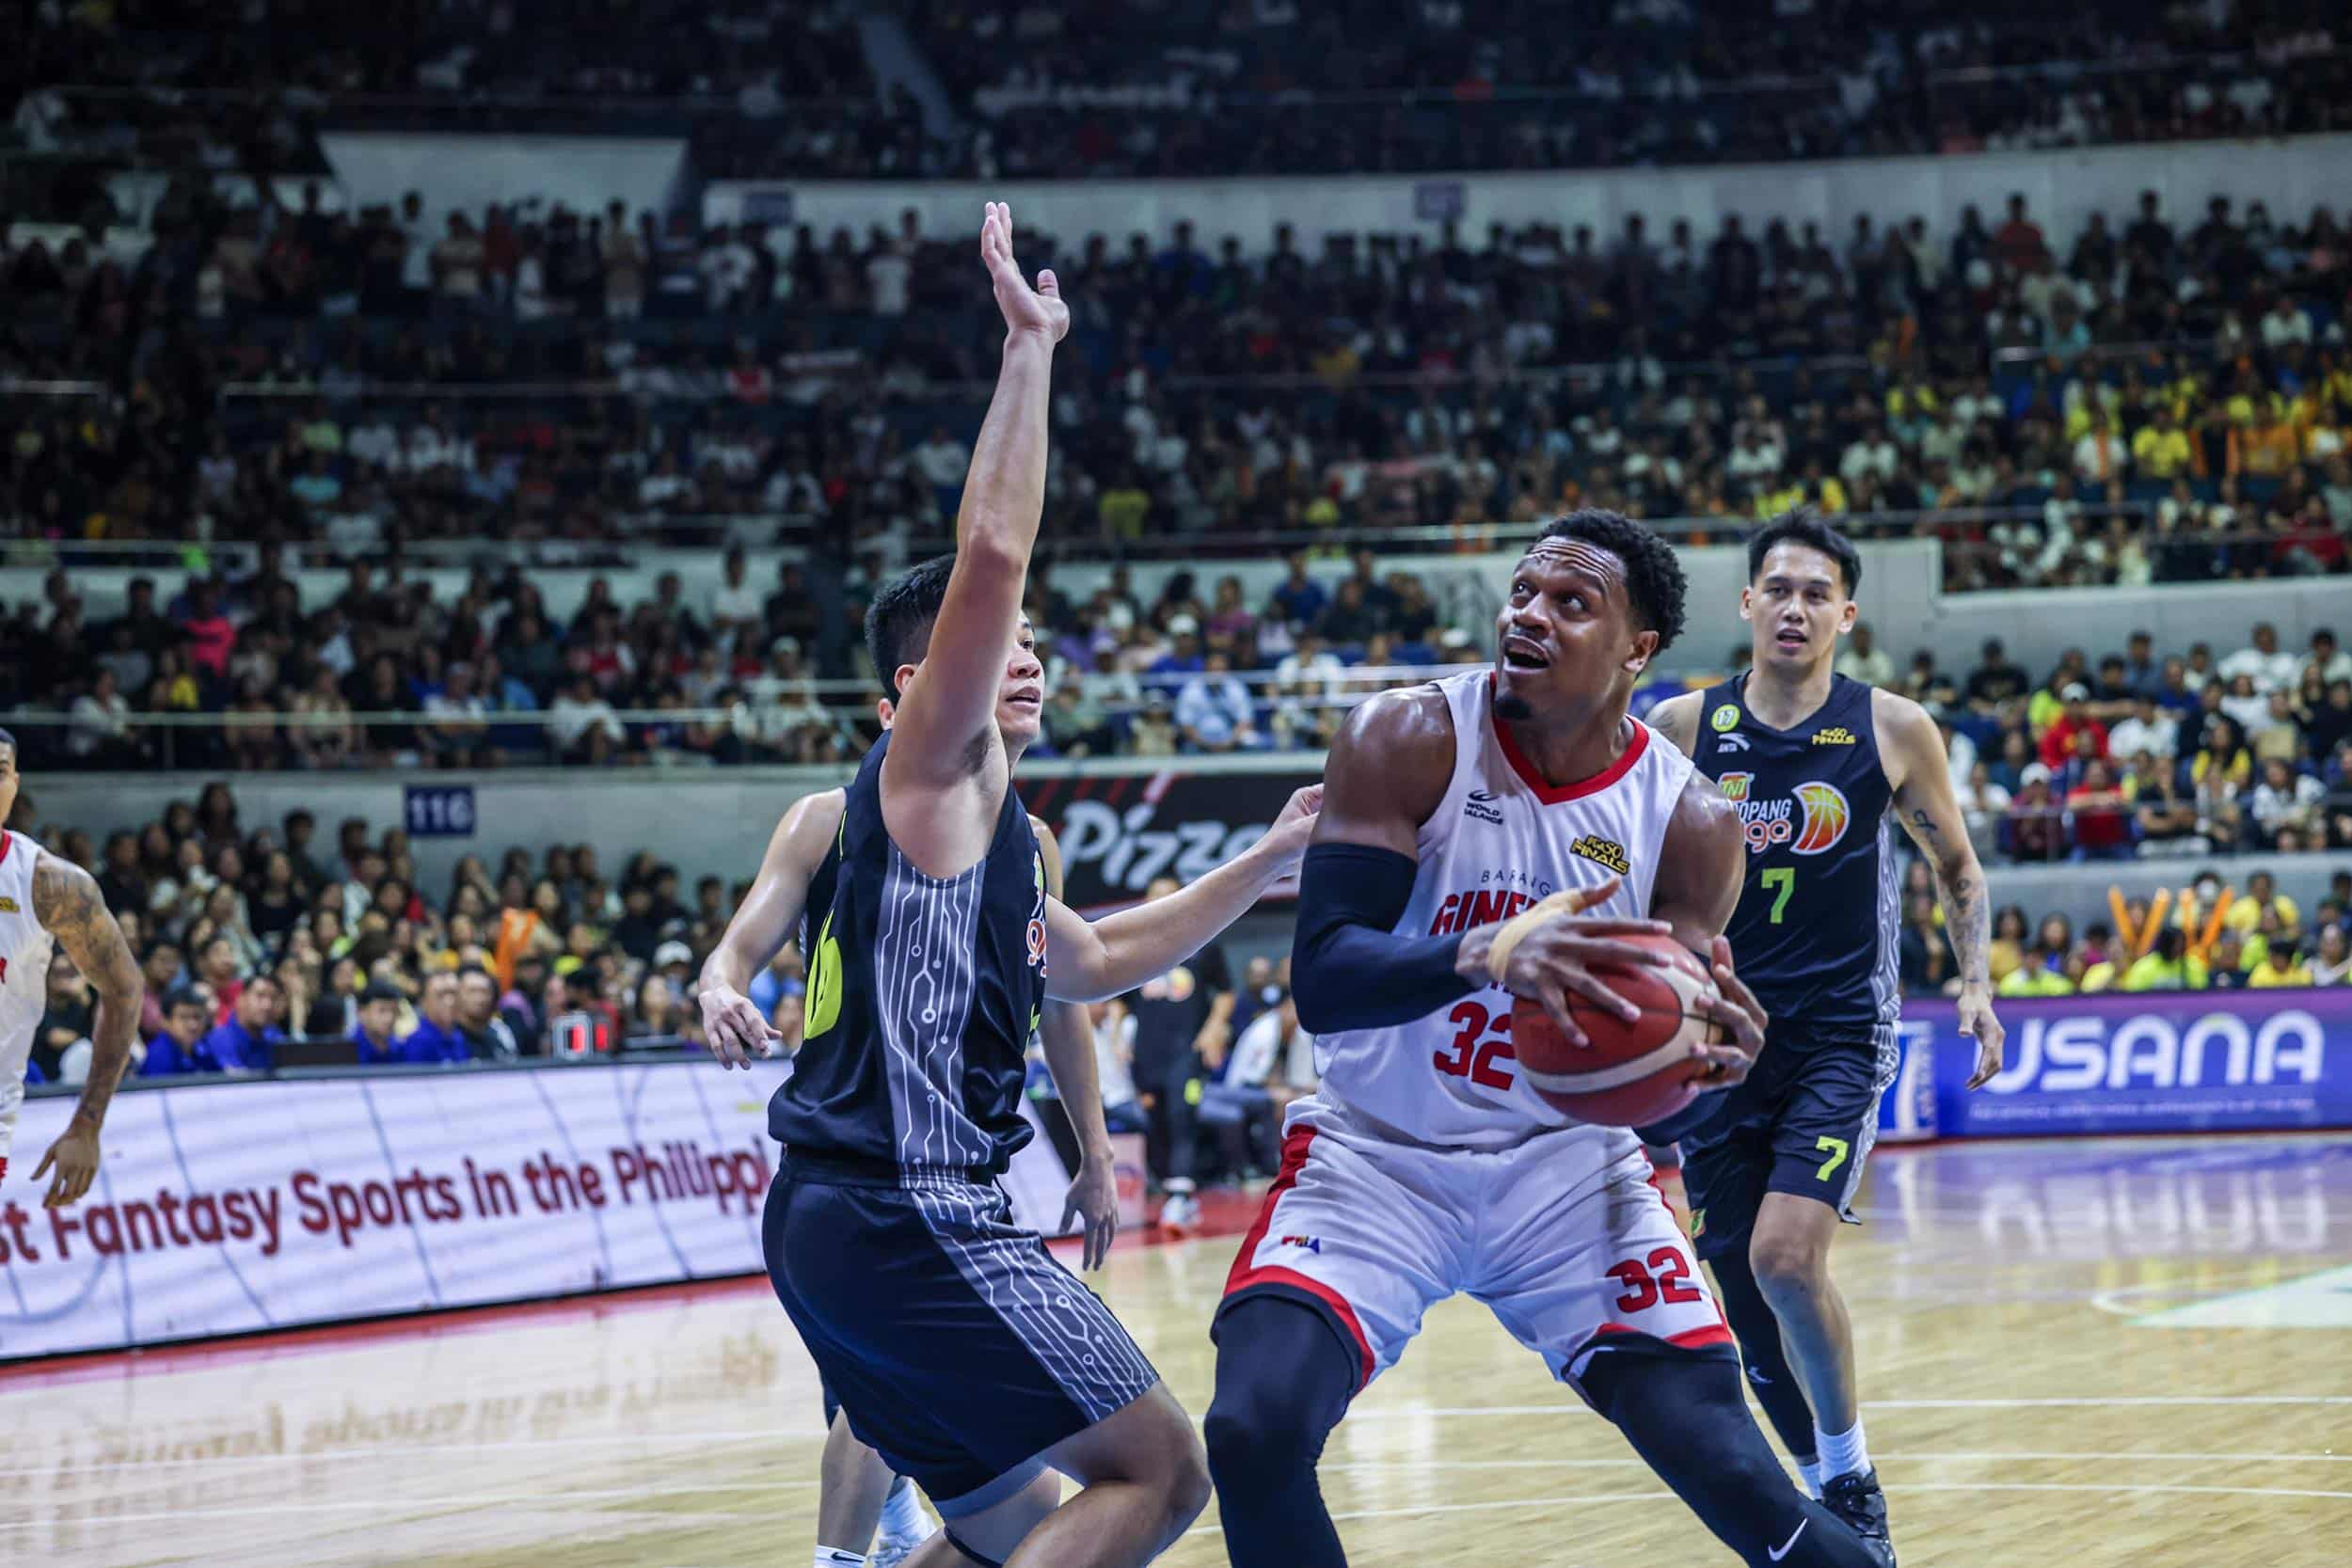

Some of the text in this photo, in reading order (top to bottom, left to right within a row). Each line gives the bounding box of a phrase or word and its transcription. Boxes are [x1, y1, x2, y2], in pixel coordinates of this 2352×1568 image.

[412, 793, 472, 829] 116
[1571, 838, 1629, 875] FINALS
[1429, 890, 1538, 936] GINE
[1761, 867, 1795, 924] 7
[1974, 1010, 2326, 1094] USANA
[1815, 1135, 1850, 1182] 7
[47, 1187, 279, 1260] Fantasy
[292, 1167, 464, 1247] Sports
[462, 1156, 518, 1218] in
[523, 1150, 608, 1214] the
[1605, 1245, 1702, 1314] 32
